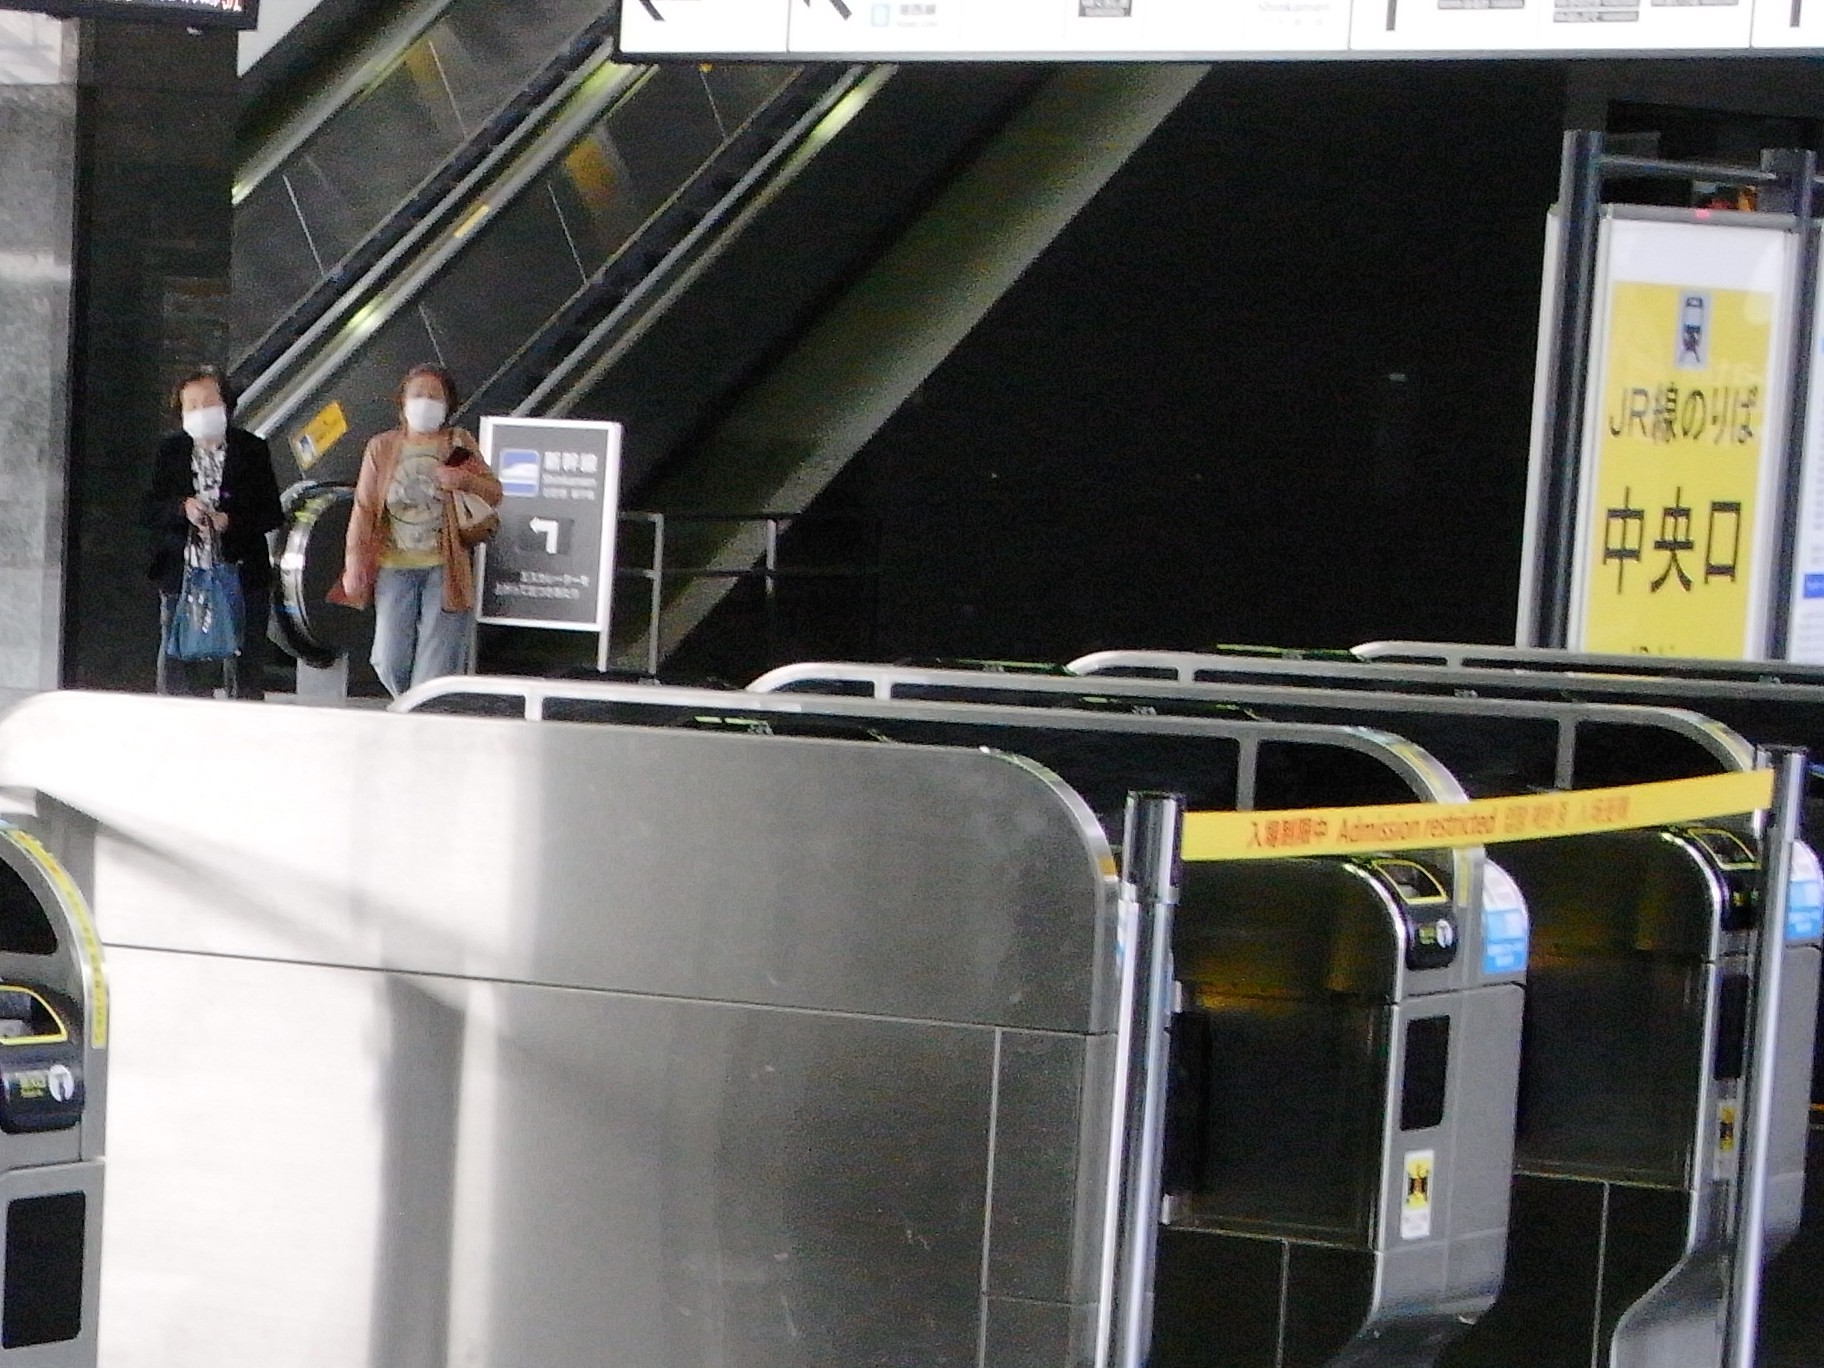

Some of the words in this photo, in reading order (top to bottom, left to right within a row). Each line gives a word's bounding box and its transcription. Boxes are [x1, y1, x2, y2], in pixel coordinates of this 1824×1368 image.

[1608, 381, 1759, 444] JR線のりば
[1602, 486, 1742, 595] 中央口
[1336, 814, 1421, 844] Admission
[1424, 810, 1498, 837] restricted
